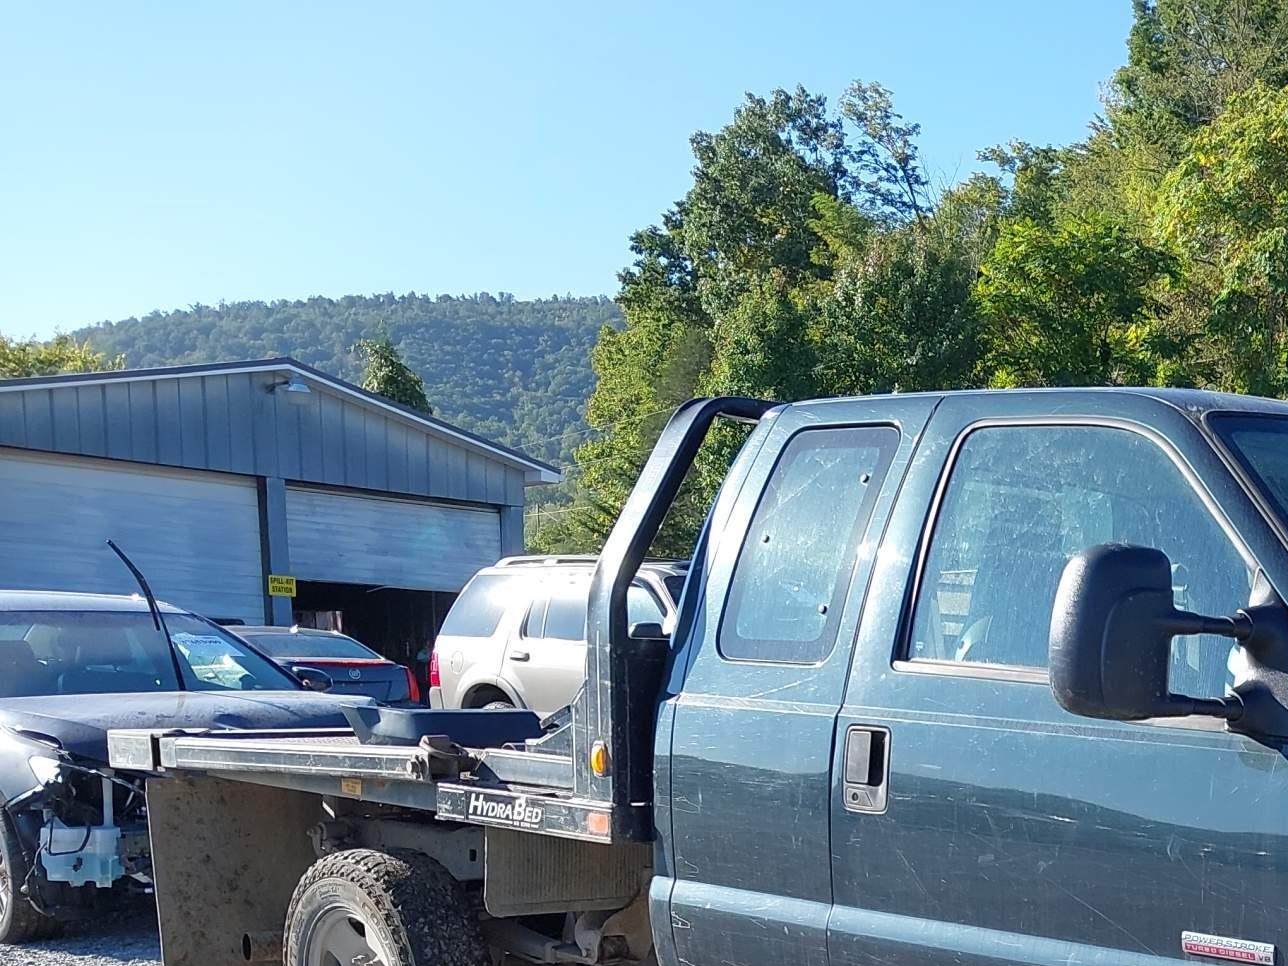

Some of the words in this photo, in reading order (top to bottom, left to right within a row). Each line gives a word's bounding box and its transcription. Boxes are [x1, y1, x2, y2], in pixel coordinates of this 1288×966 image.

[1186, 944, 1218, 954] TURBO
[1219, 949, 1255, 960] DIESEL
[1258, 954, 1272, 963] V8
